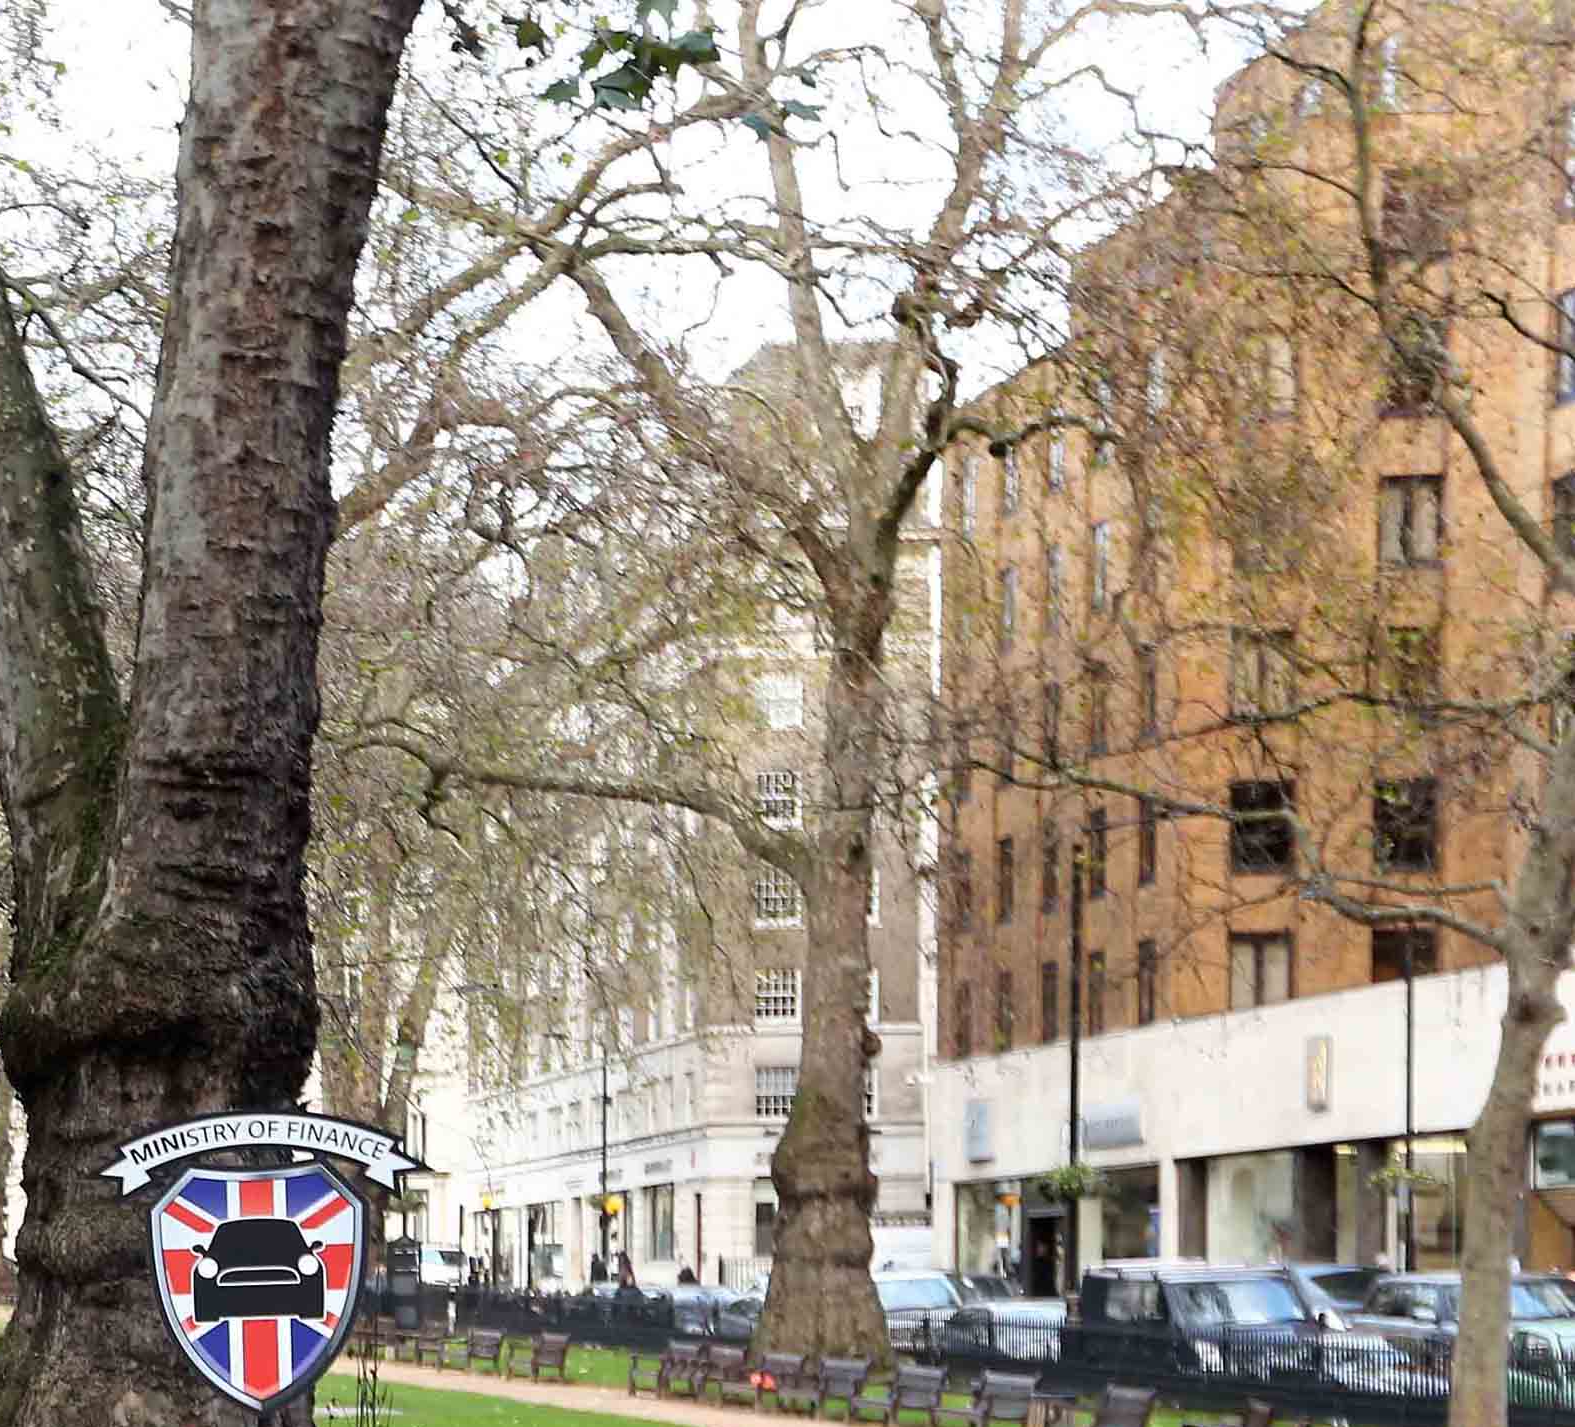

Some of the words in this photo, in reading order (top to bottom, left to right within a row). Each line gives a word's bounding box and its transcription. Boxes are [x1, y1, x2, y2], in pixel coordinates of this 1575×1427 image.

[129, 1122, 241, 1165] MINISTRY
[248, 1120, 278, 1139] OF
[287, 1121, 388, 1160] FINANCE
